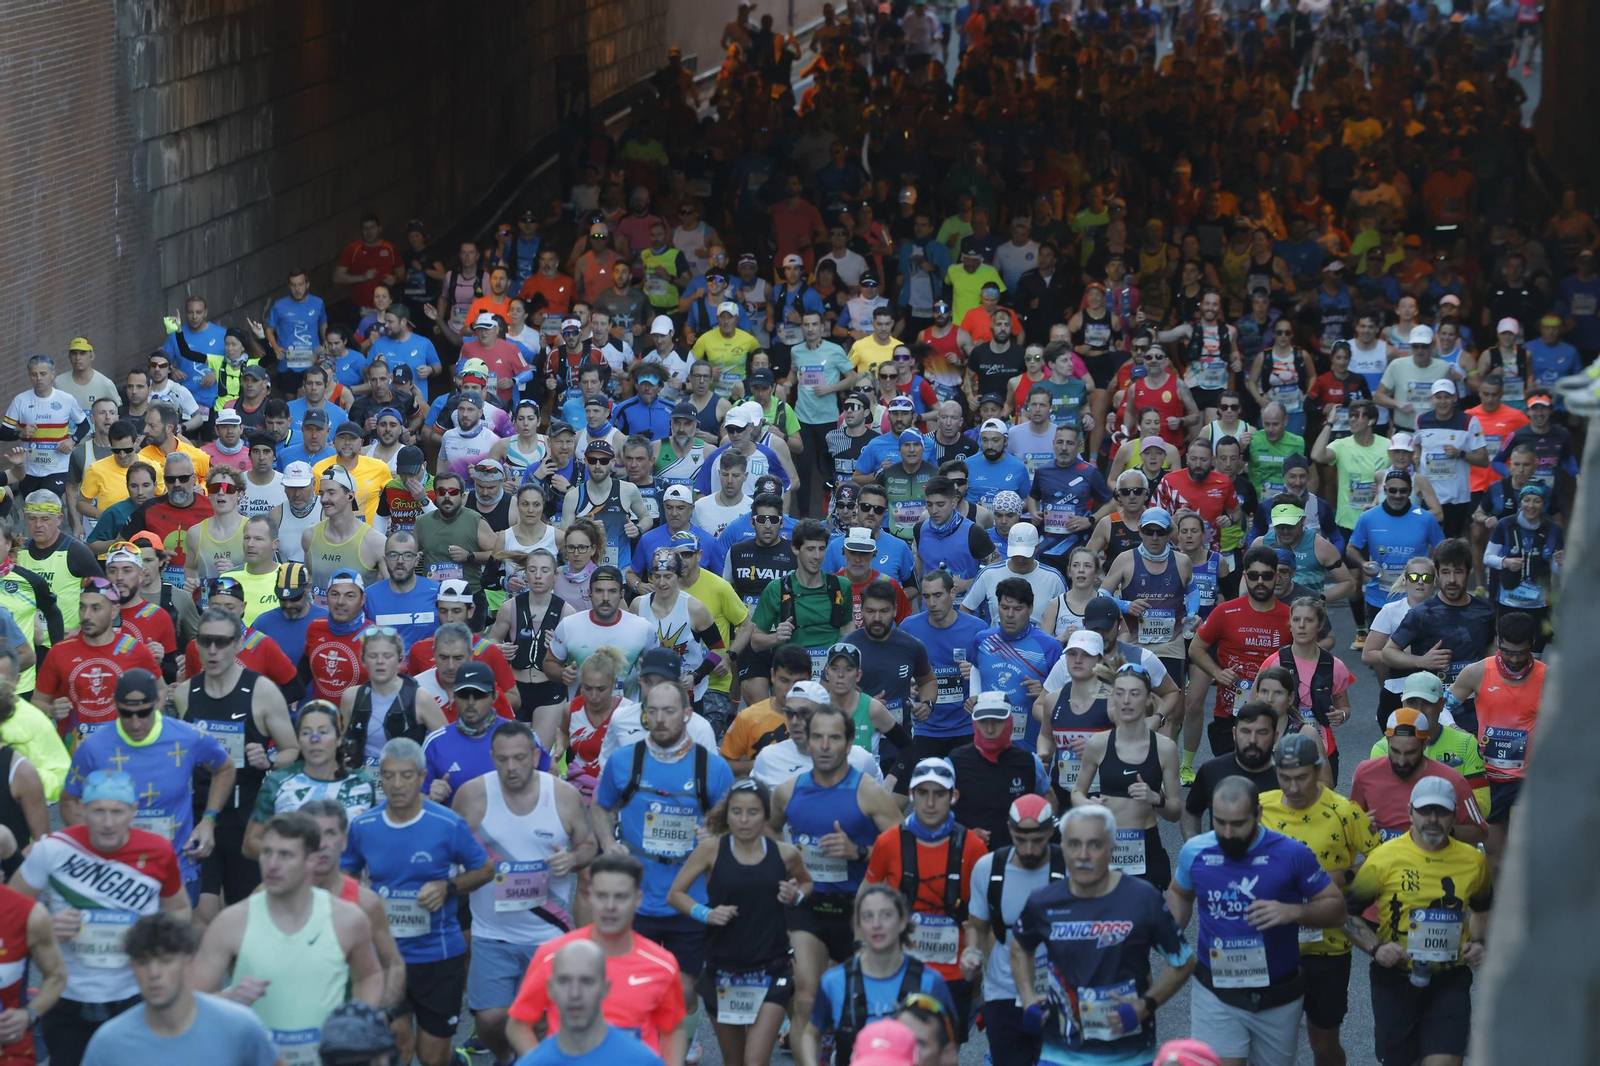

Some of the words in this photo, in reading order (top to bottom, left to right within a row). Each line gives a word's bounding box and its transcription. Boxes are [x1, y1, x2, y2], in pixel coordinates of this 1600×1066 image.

[322, 554, 341, 562] ANR
[1142, 627, 1169, 636] MARTOS
[1245, 636, 1271, 647] MÁLAGA
[937, 687, 963, 695] BELTRÃO
[210, 723, 238, 731] ZURICH
[1496, 728, 1522, 737] ZURICH
[1497, 749, 1506, 759] SI
[664, 805, 694, 815] ZURICH
[652, 828, 688, 840] BERBEL
[513, 863, 543, 871] ZURICH
[57, 853, 154, 914] HUNGARY
[391, 889, 419, 898] ZURIC
[505, 886, 540, 899] SHAUN
[1207, 891, 1239, 901] 1944
[1227, 902, 1250, 912] 202
[93, 914, 131, 923] ZURICH
[387, 914, 426, 925] OVANNI
[1428, 913, 1458, 921] ZURICH
[1050, 921, 1133, 941] TONICDOGS
[1226, 939, 1257, 948] ZURICH
[1424, 938, 1448, 949] DOM
[1227, 955, 1247, 963] 11374
[1235, 968, 1267, 977] BAYONNE
